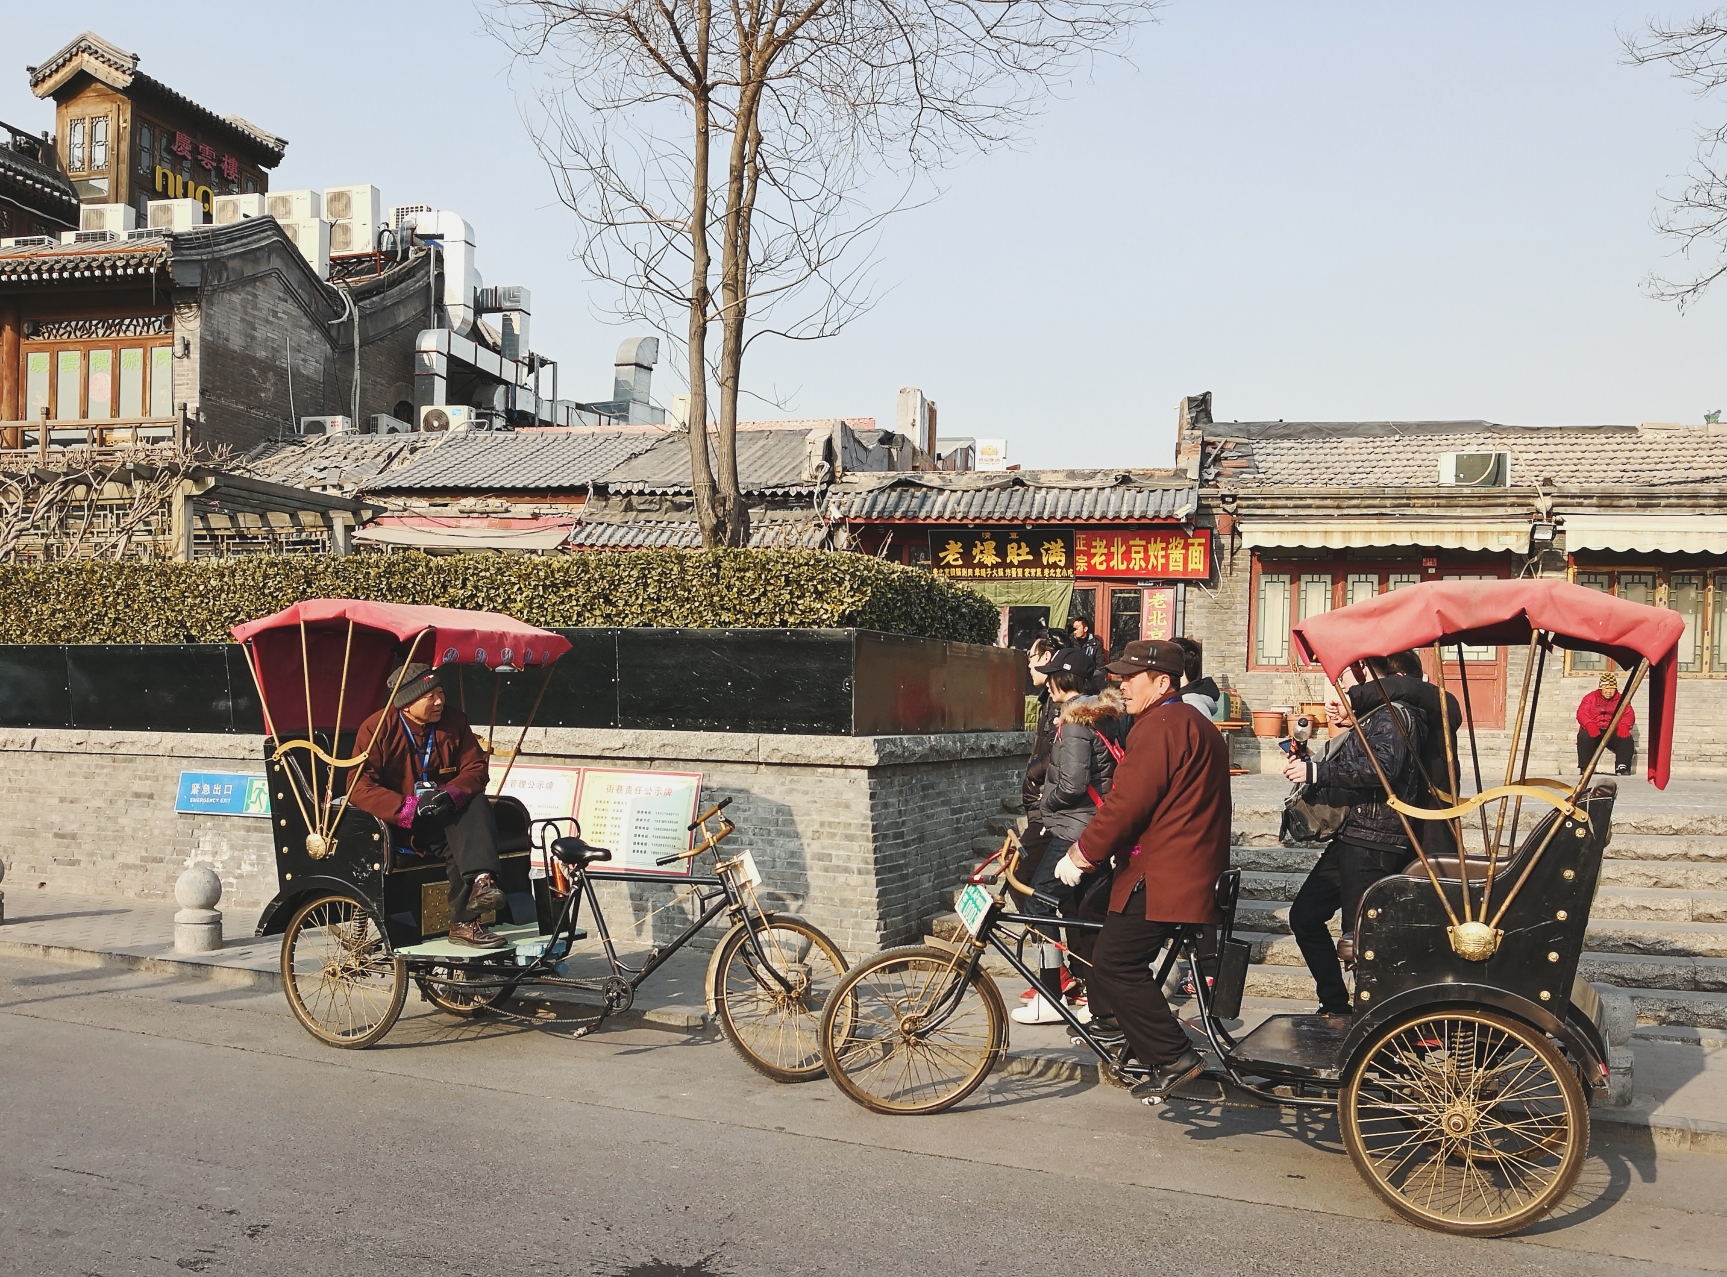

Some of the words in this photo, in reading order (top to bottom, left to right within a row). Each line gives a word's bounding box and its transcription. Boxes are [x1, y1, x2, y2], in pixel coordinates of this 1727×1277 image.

[171, 131, 240, 181] 慶雲樓
[938, 538, 1067, 567] 老爆肚满
[1075, 534, 1088, 572] 正宗
[1090, 537, 1206, 572] 老北京炸酱面
[190, 783, 233, 795] 紧急出口
